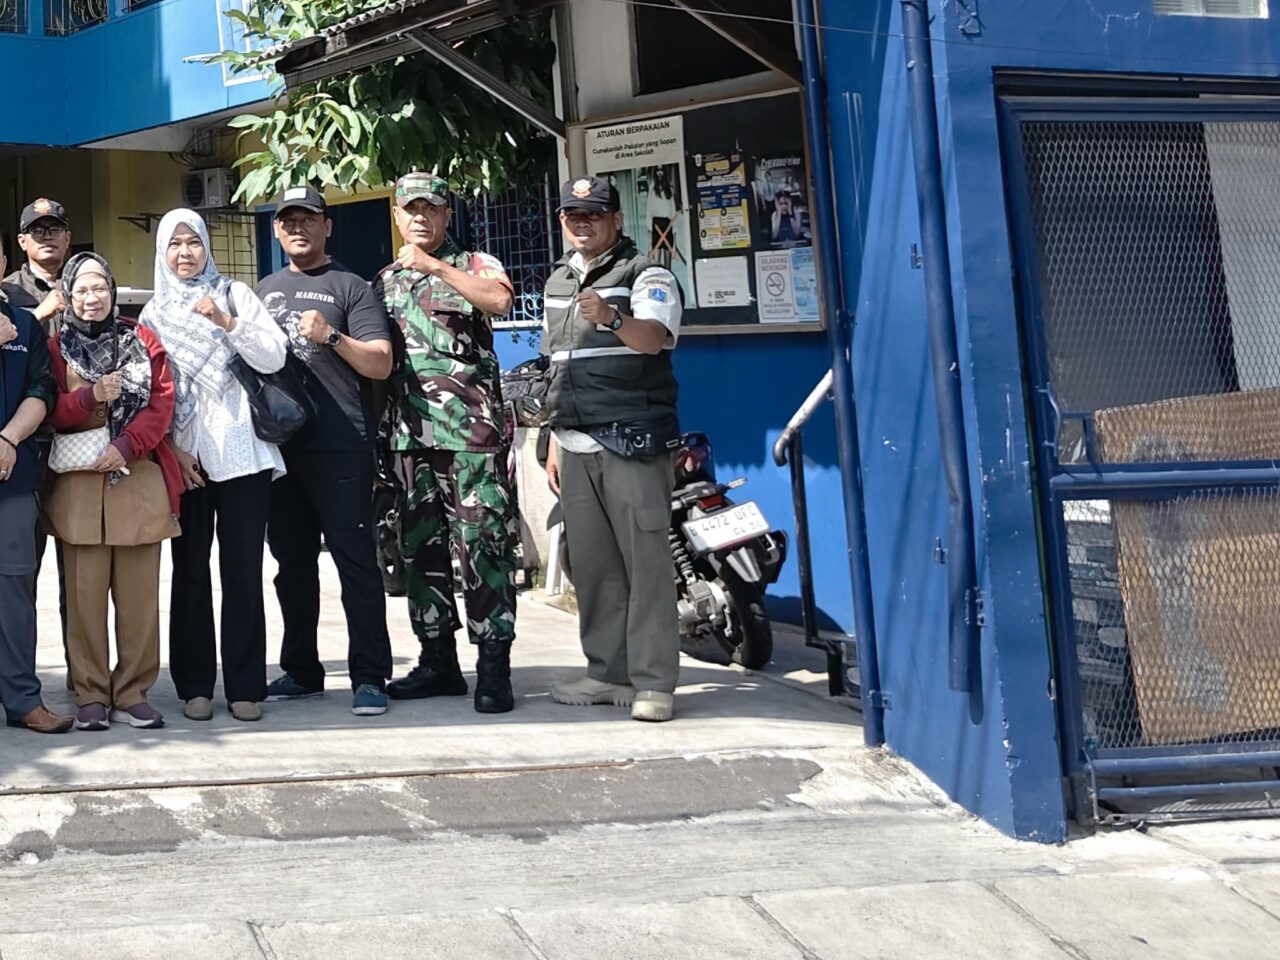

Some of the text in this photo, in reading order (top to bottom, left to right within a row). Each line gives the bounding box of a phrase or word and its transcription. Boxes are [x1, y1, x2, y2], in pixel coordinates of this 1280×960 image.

[596, 121, 670, 139] ATURAN BERPAKAIAN
[294, 290, 335, 303] MARINIR
